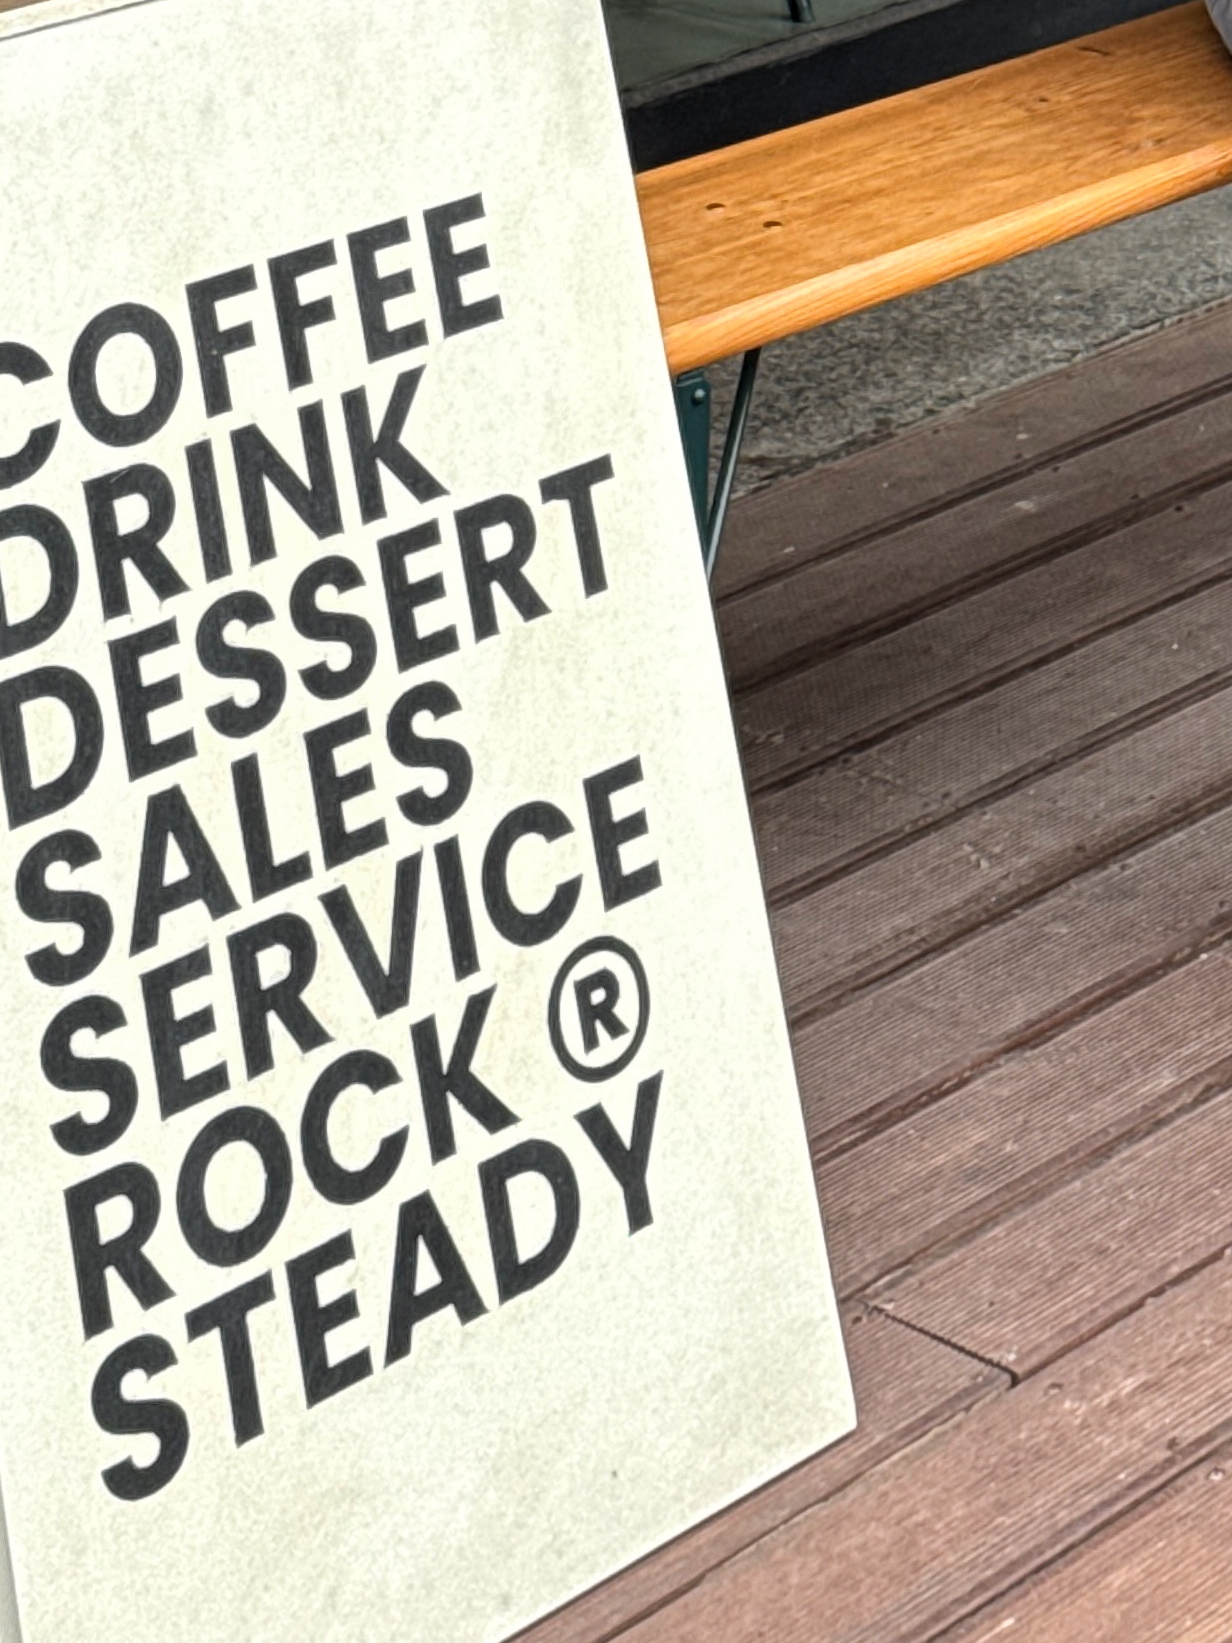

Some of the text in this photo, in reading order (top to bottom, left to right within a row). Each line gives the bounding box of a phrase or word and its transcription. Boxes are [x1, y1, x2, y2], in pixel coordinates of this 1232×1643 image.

[0, 194, 503, 491] COFFEE
[0, 363, 450, 660] DRINK
[0, 454, 614, 830] DESSERT
[13, 679, 474, 988] SALES
[39, 755, 662, 1156] SERVICE
[63, 982, 520, 1344] ROCK
[90, 1069, 664, 1502] STEADY
